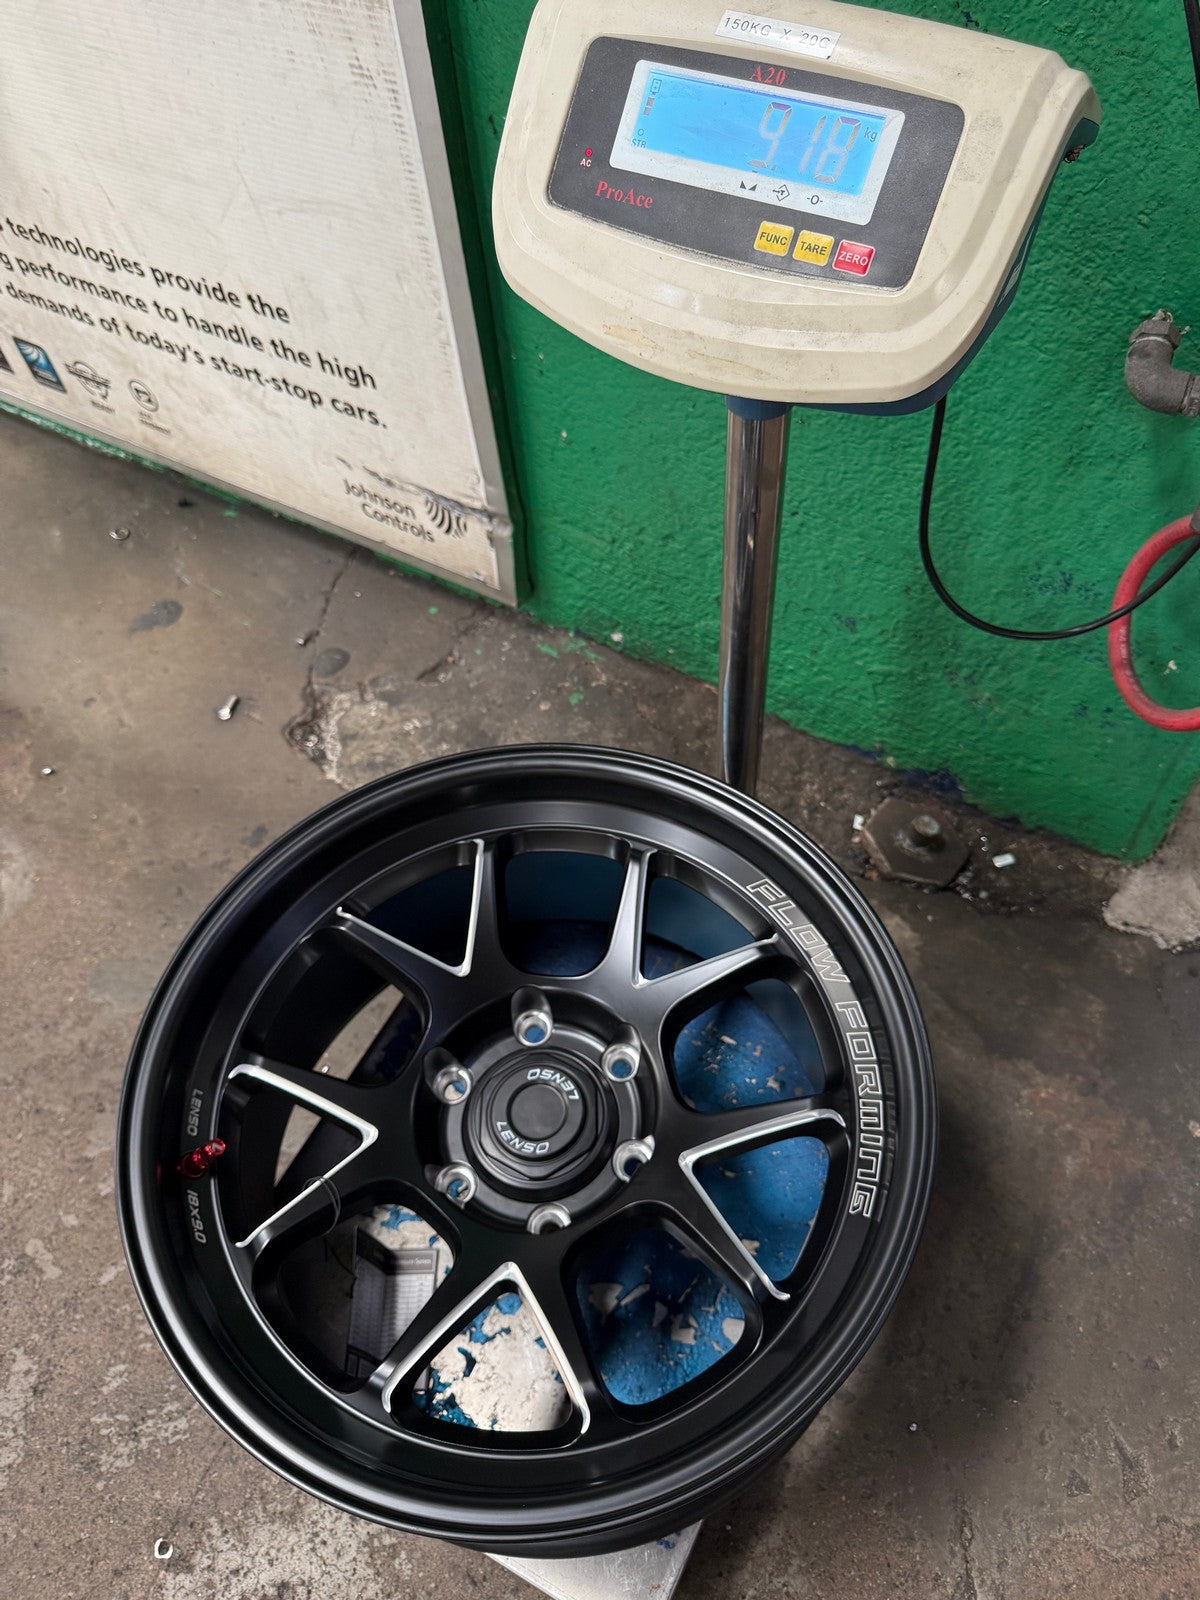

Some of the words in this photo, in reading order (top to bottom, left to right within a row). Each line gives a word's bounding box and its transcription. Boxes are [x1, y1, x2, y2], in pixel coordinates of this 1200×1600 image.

[724, 17, 771, 37] 150KG
[749, 65, 787, 86] A20
[631, 138, 647, 149] STR
[863, 127, 878, 143] kg
[580, 158, 592, 168] AC
[595, 180, 653, 209] ProAce
[759, 231, 788, 246] FUNC
[800, 241, 827, 256] TARE
[5, 217, 146, 278] technologies
[150, 266, 242, 308] provide
[246, 294, 291, 324] the
[838, 250, 869, 267] ZERO
[15, 256, 149, 314] performance
[152, 300, 179, 323] to
[181, 307, 264, 351] handle
[269, 339, 312, 368] the
[317, 352, 377, 390] high
[5, 281, 95, 327] demands
[99, 317, 122, 337] of
[124, 322, 206, 365] today's
[210, 355, 324, 408] start-stop
[330, 397, 389, 430] cars.
[343, 479, 417, 520] Johnson
[361, 502, 435, 543] Controls
[746, 878, 851, 983] FLOW
[835, 1000, 884, 1218] FORMING
[526, 1067, 580, 1100] LENSO
[187, 1088, 203, 1137] LENSO
[496, 1121, 550, 1155] LENSO
